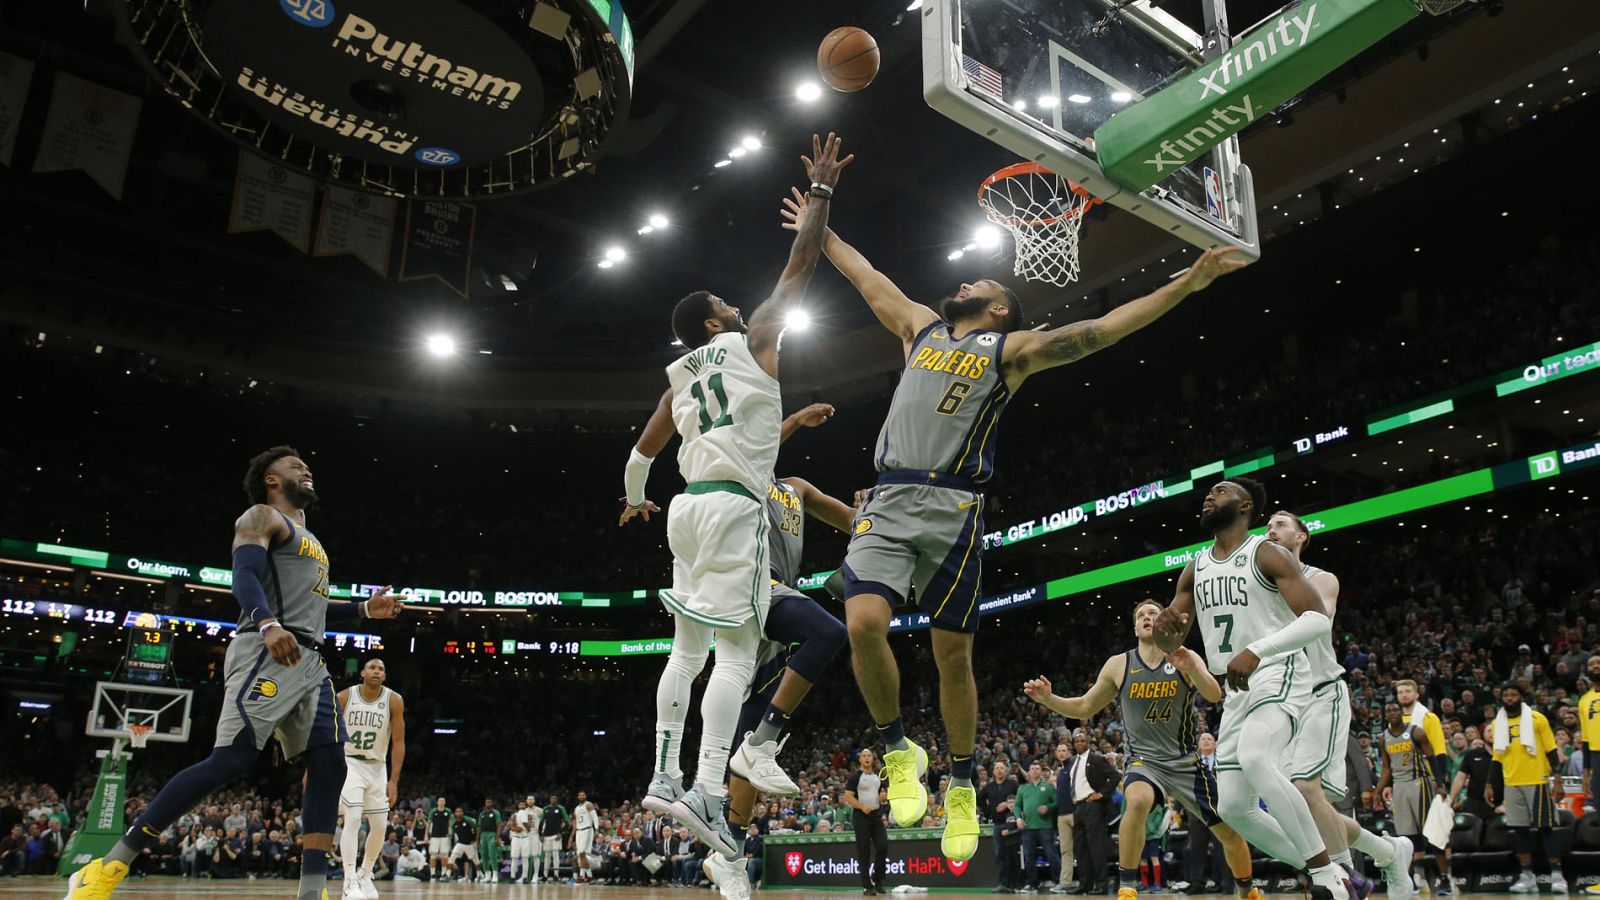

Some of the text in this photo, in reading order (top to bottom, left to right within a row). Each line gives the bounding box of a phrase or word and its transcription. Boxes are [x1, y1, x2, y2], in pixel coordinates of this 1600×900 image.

[337, 13, 522, 101] Putnam
[1198, 3, 1317, 101] xfinity
[332, 38, 511, 110] INVESTMENTS
[237, 73, 414, 155] Putnam
[242, 66, 419, 142] INVESTMENTS
[1143, 94, 1255, 172] xfinity
[684, 346, 727, 377] IRVING
[911, 346, 991, 380] PACERS
[1523, 361, 1560, 382] Our
[690, 372, 734, 435] 11
[935, 380, 972, 416] 6
[1293, 426, 1349, 453] TD Bank
[1531, 456, 1556, 474] TD
[1008, 520, 1035, 542] GET
[1042, 506, 1088, 533] LOUD,
[1095, 480, 1169, 517] BOSTON.
[127, 558, 191, 577] Our team.
[1164, 551, 1195, 567] Bank
[199, 569, 223, 580] Our
[797, 577, 815, 588] Our
[440, 591, 487, 606] LOUD,
[494, 592, 562, 605] BOSTON.
[1195, 575, 1249, 612] CELTICS
[2, 599, 116, 623] 112 1.7 112
[1213, 614, 1234, 653] 7
[517, 642, 541, 650] Bank
[550, 642, 579, 654] 9:18
[621, 642, 671, 652] Bank of the
[1129, 680, 1178, 699] PACERS
[348, 711, 384, 728] CELTICS
[1144, 700, 1173, 724] 44
[351, 730, 377, 750] 42
[804, 858, 826, 874] Get
[908, 857, 945, 874] HaPi.
[1480, 875, 1513, 885] jetBlue
